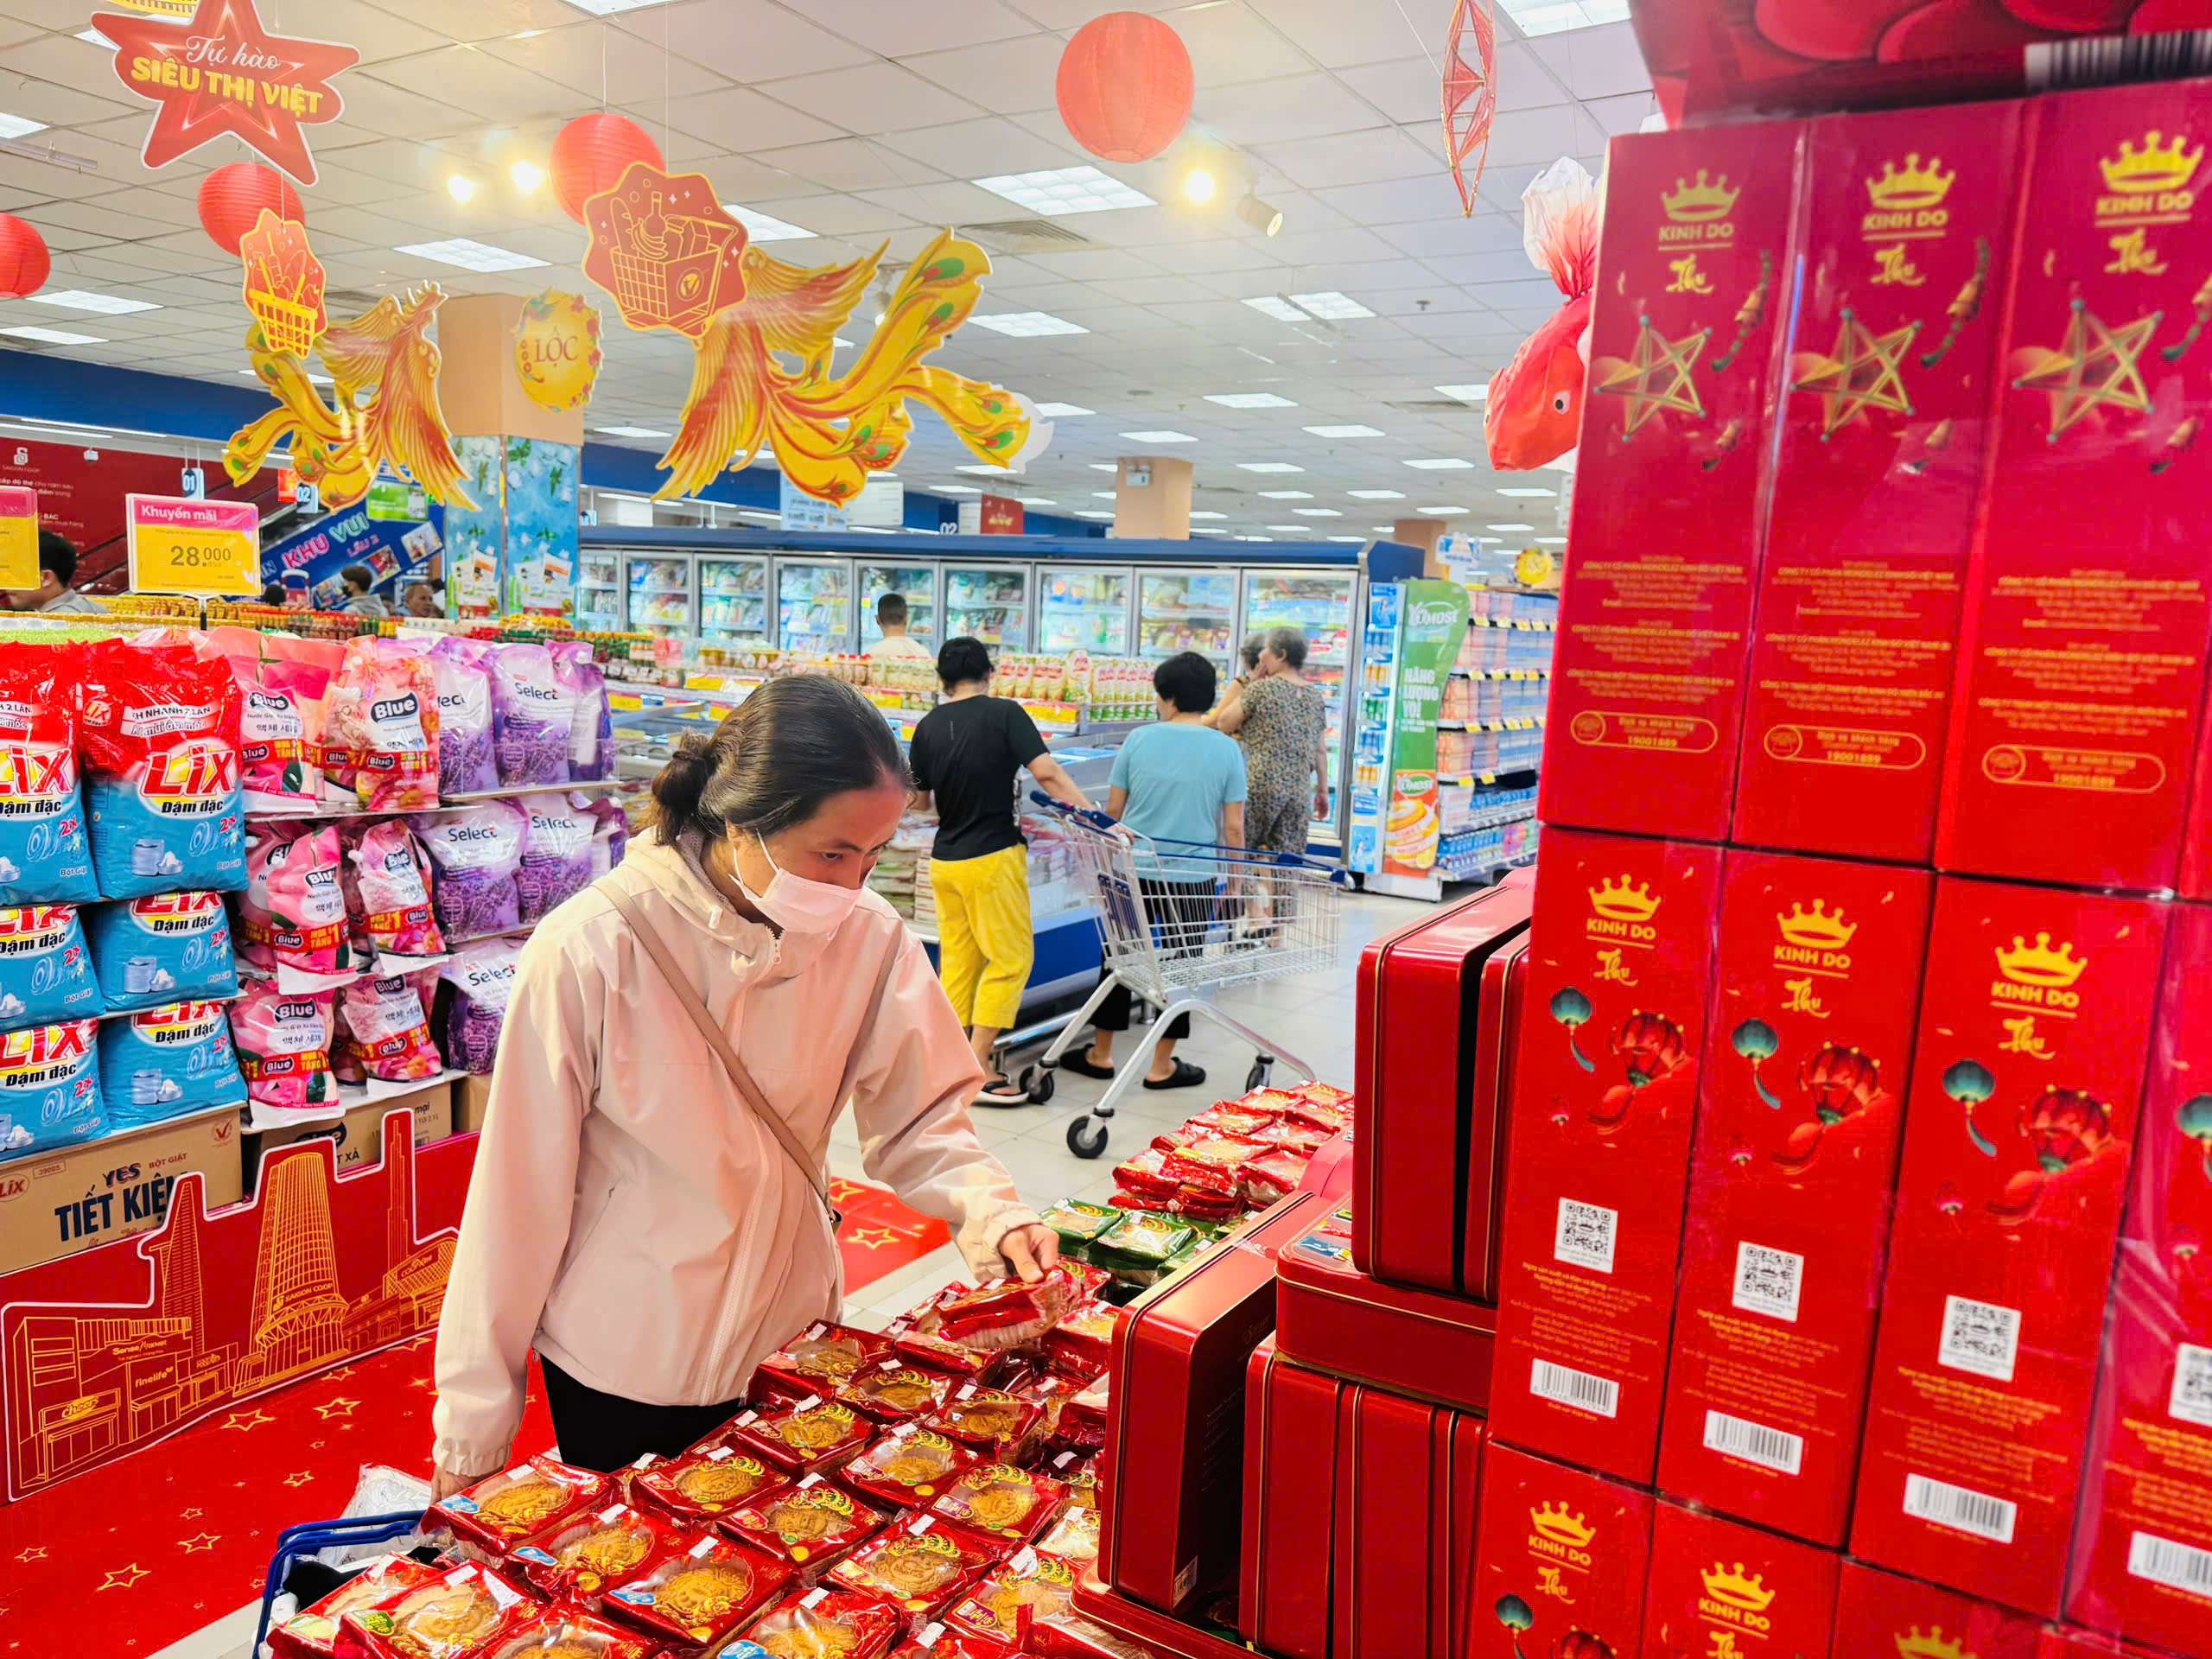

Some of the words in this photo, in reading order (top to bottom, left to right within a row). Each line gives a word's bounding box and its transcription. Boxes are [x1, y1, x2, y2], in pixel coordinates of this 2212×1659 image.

[186, 35, 228, 67] Tự
[232, 42, 280, 69] hào
[131, 55, 200, 92] SIÊU
[205, 70, 255, 109] THỊ
[261, 81, 323, 118] VIỆT
[2095, 196, 2153, 215] KINH
[2158, 192, 2193, 211] DO
[1862, 213, 1911, 231] KINH
[1916, 209, 1948, 226] DO
[1659, 225, 1701, 241] KINH
[1706, 224, 1733, 238] DO
[535, 326, 580, 367] LỘC
[182, 475, 195, 492] 01
[141, 505, 191, 521] Khuyến
[330, 512, 369, 543] VUI
[170, 545, 200, 567] 28
[203, 548, 231, 562] 000
[283, 534, 329, 568] KHU
[253, 693, 286, 708] Blue
[516, 682, 558, 700] Select
[373, 698, 416, 720] Blue
[370, 756, 391, 766] Blue
[0, 801, 31, 817] ậm
[35, 799, 61, 816] đặc
[162, 800, 197, 816] Đậm
[200, 799, 224, 814] đặc
[448, 824, 498, 842] Select
[308, 871, 336, 885] Blu
[154, 918, 188, 934] Đậm
[192, 916, 214, 930] đặc
[1586, 918, 1629, 936] KINH
[1630, 924, 1657, 940] DO
[39, 932, 66, 948] đặc
[277, 934, 301, 945] Blue
[1774, 945, 1819, 965] KINH
[1822, 952, 1851, 969] DO
[375, 979, 402, 993] Blue
[1992, 982, 2043, 1003] KINH
[2046, 989, 2080, 1008] DO
[278, 1004, 314, 1019] Blue
[156, 1028, 191, 1044] Đậm
[194, 1023, 215, 1039] đặc
[5, 1071, 45, 1088] Đậm
[49, 1064, 77, 1080] đặc
[266, 1060, 291, 1071] Blue
[103, 1162, 142, 1188] YES
[54, 1184, 114, 1243] TIẾT
[285, 1287, 312, 1301] SAIGON
[1529, 1536, 1566, 1556] KINH
[1568, 1548, 1591, 1567] DO
[1699, 1597, 1740, 1622] KINH
[1744, 1611, 1770, 1631] DO
